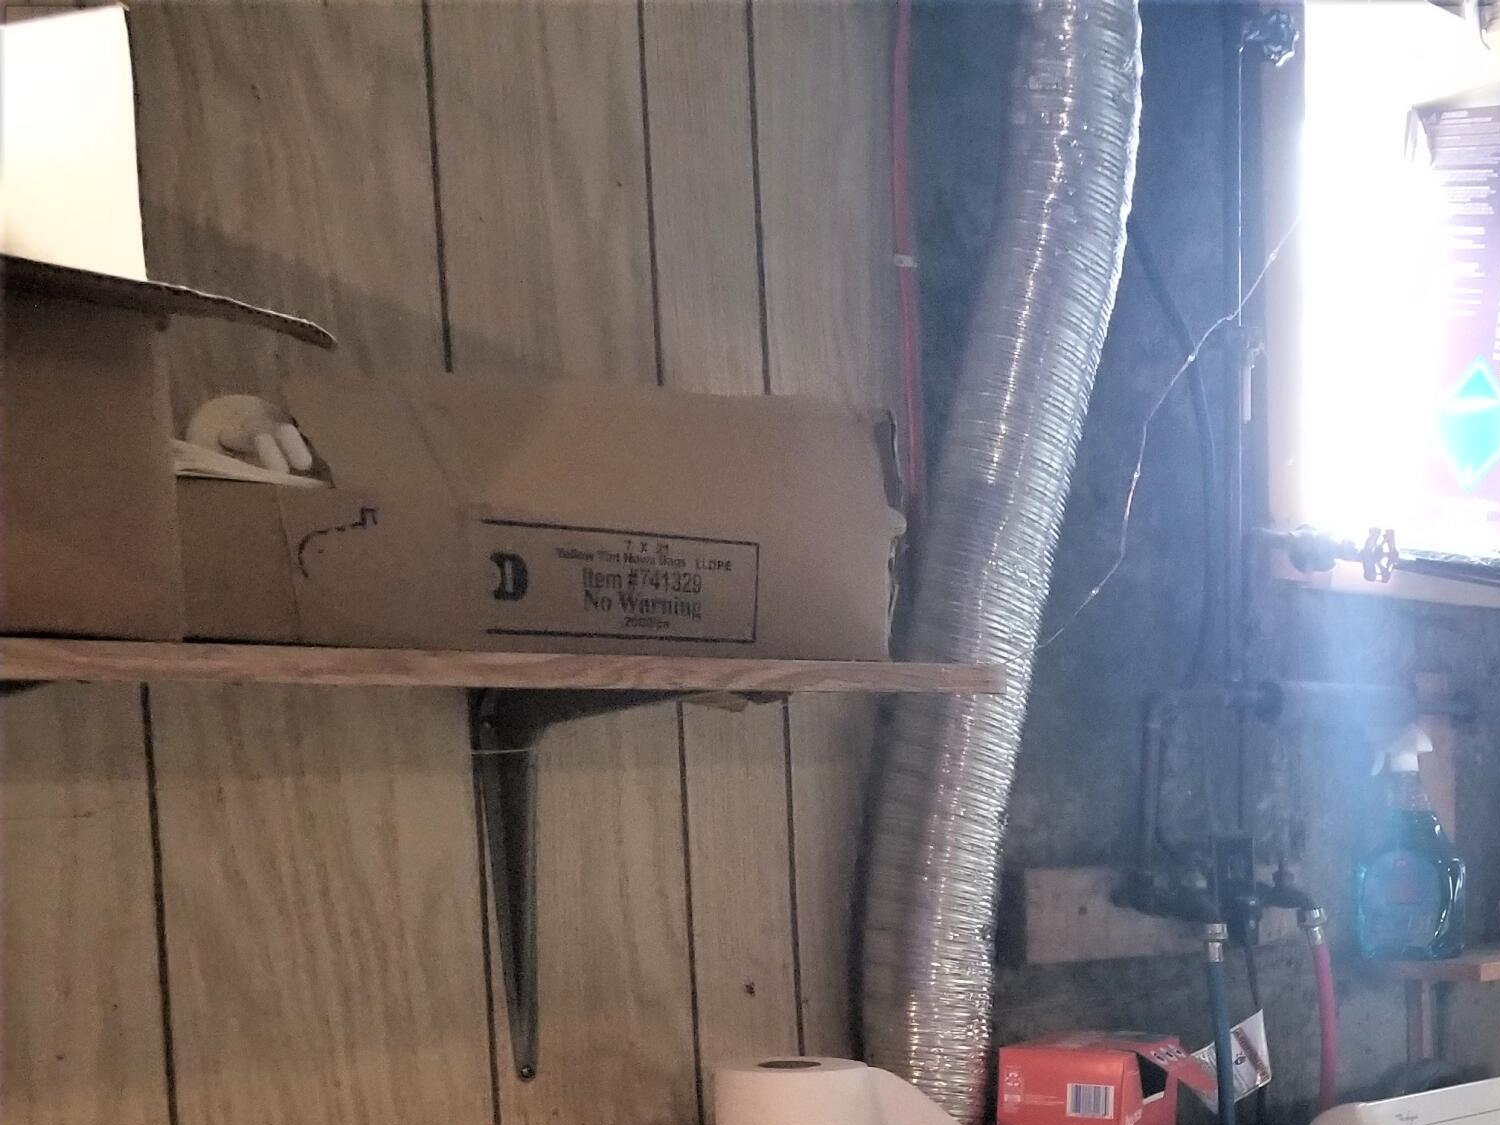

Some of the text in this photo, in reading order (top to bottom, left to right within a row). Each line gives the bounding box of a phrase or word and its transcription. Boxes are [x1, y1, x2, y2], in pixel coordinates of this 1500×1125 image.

[583, 567, 622, 589] Item
[582, 588, 702, 621] No Warning
